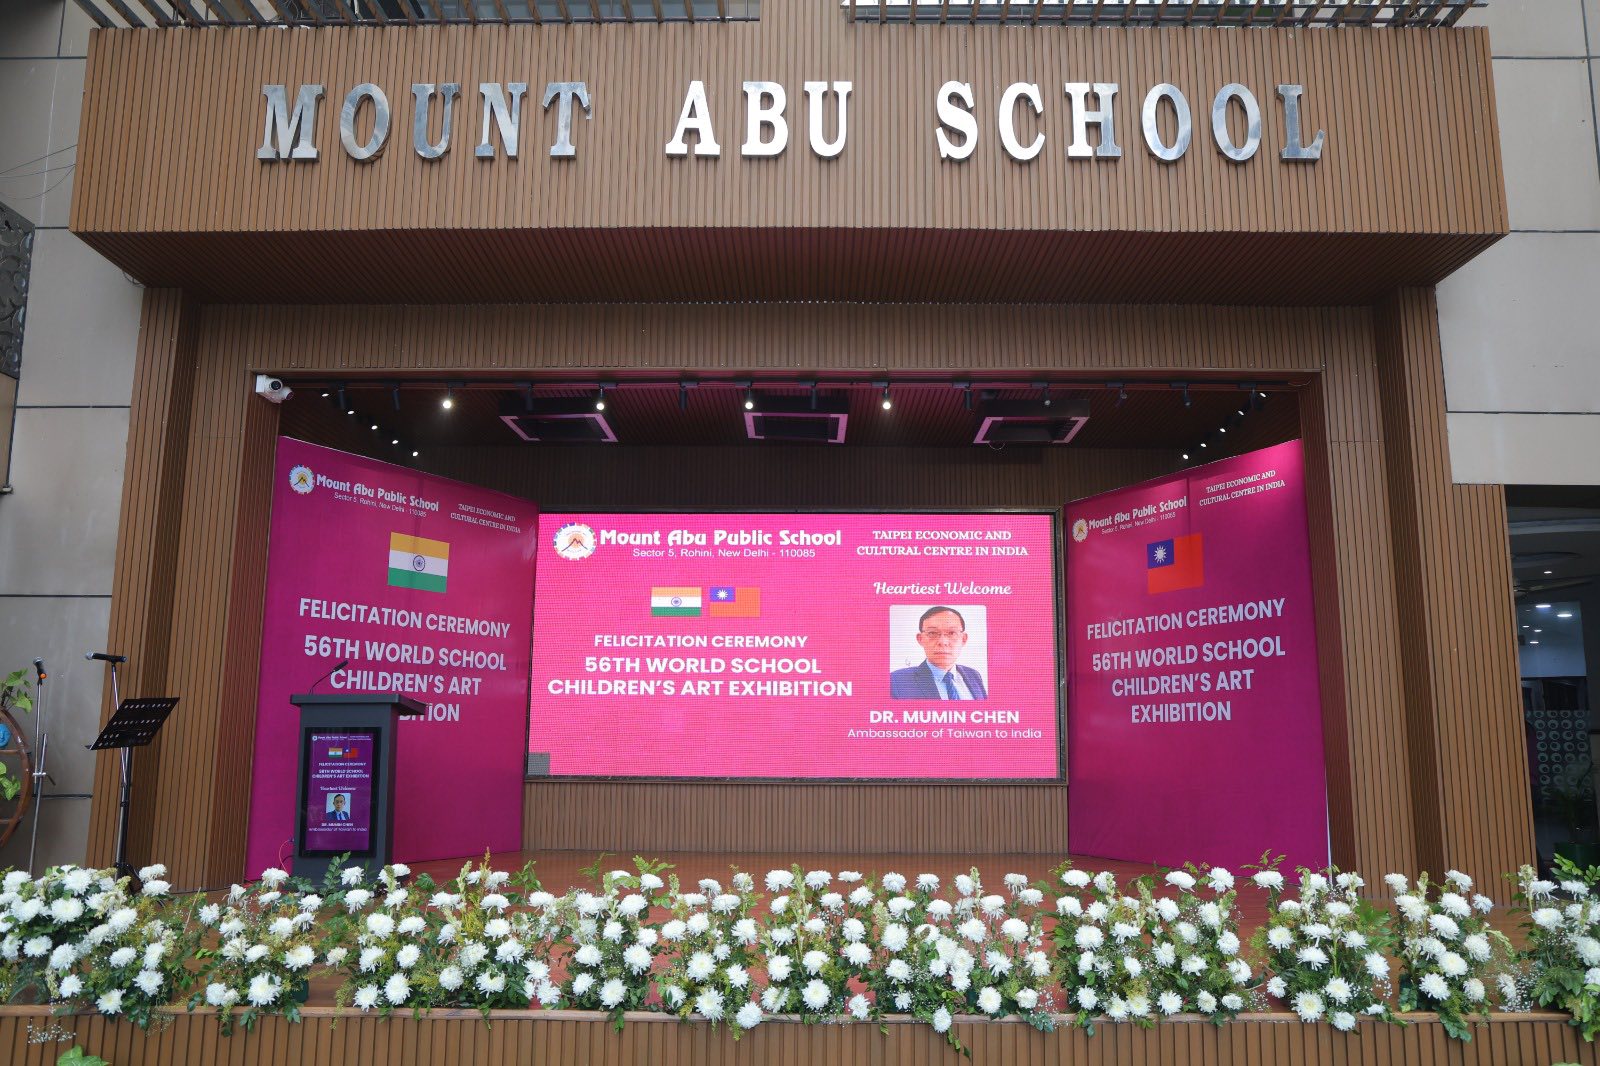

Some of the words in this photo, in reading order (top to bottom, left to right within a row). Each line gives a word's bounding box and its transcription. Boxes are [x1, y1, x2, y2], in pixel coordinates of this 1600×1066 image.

[257, 82, 592, 161] MOUNT
[665, 80, 853, 158] ABU
[936, 80, 1325, 164] SCHOOL
[316, 473, 351, 492] Mount
[353, 483, 374, 498] Abu
[377, 487, 407, 505] Public
[409, 495, 439, 512] School
[1206, 482, 1226, 494] TAIPEI
[1226, 474, 1261, 490] ECONOMIC
[1261, 470, 1276, 480] AND
[334, 492, 352, 502] Sector
[391, 504, 405, 513] Delhi
[1199, 493, 1231, 507] CULTURAL
[1230, 486, 1256, 499] CENTRE
[1256, 484, 1264, 493] IN
[1265, 480, 1285, 491] INDIA
[450, 512, 478, 524] CULTURAL
[479, 518, 500, 529] CENTRE
[500, 523, 506, 531] IN
[504, 514, 516, 523] AND
[1088, 515, 1112, 530] Mount
[1114, 512, 1130, 524] Abu
[1132, 504, 1157, 519] Public
[1159, 495, 1187, 512] School
[600, 530, 660, 545] Mount
[668, 530, 706, 546] Abu
[714, 530, 772, 546] Public
[779, 530, 841, 546] School
[872, 530, 912, 540] TAIPEI
[915, 530, 984, 540] ECONOMIC
[985, 530, 1012, 540] AND
[632, 548, 665, 557] Sector
[667, 549, 677, 559] 5,
[680, 549, 715, 559] Rohini,
[718, 549, 740, 557] New
[743, 549, 769, 558] Delhi
[779, 549, 816, 558] 110085
[856, 546, 921, 556] CULTURAL
[923, 546, 973, 556] CENTRE
[975, 546, 990, 556] IN
[992, 546, 1029, 556] INDIA
[873, 581, 941, 595] Heartiest
[943, 581, 1012, 595] Welcome
[299, 597, 423, 629] FELICITATION
[425, 613, 511, 638] CEREMONY
[1087, 612, 1183, 640] FELICITATION
[1186, 597, 1286, 628] CEREMONY
[594, 634, 707, 648] FELICITATION
[711, 635, 808, 648] CEREMONY
[304, 635, 360, 660] 56TH
[365, 641, 434, 665] WORLD
[438, 648, 507, 671] SCHOOL
[1092, 651, 1132, 672] 56TH
[1135, 645, 1198, 668] WORLD
[1202, 635, 1286, 662] SCHOOL
[585, 657, 640, 673] 56TH
[645, 658, 726, 673] WORLD
[730, 658, 822, 674] SCHOOL
[330, 668, 444, 693] CHILDREN'S
[447, 676, 482, 696] ART
[547, 680, 675, 695] CHILDREN'S
[680, 681, 723, 696] ART
[729, 681, 853, 697] EXHIBITION
[1111, 672, 1211, 697] CHILDREN'S
[1215, 669, 1254, 691] ART
[869, 711, 899, 723] DR.
[903, 711, 966, 724] MUMIN
[970, 711, 1020, 724] CHEN
[1131, 700, 1231, 723] EXHIBITION
[848, 729, 928, 739] Ambassador
[932, 729, 944, 738] of
[948, 729, 992, 739] Taiwan
[995, 729, 1008, 739] to
[1011, 729, 1042, 739] India
